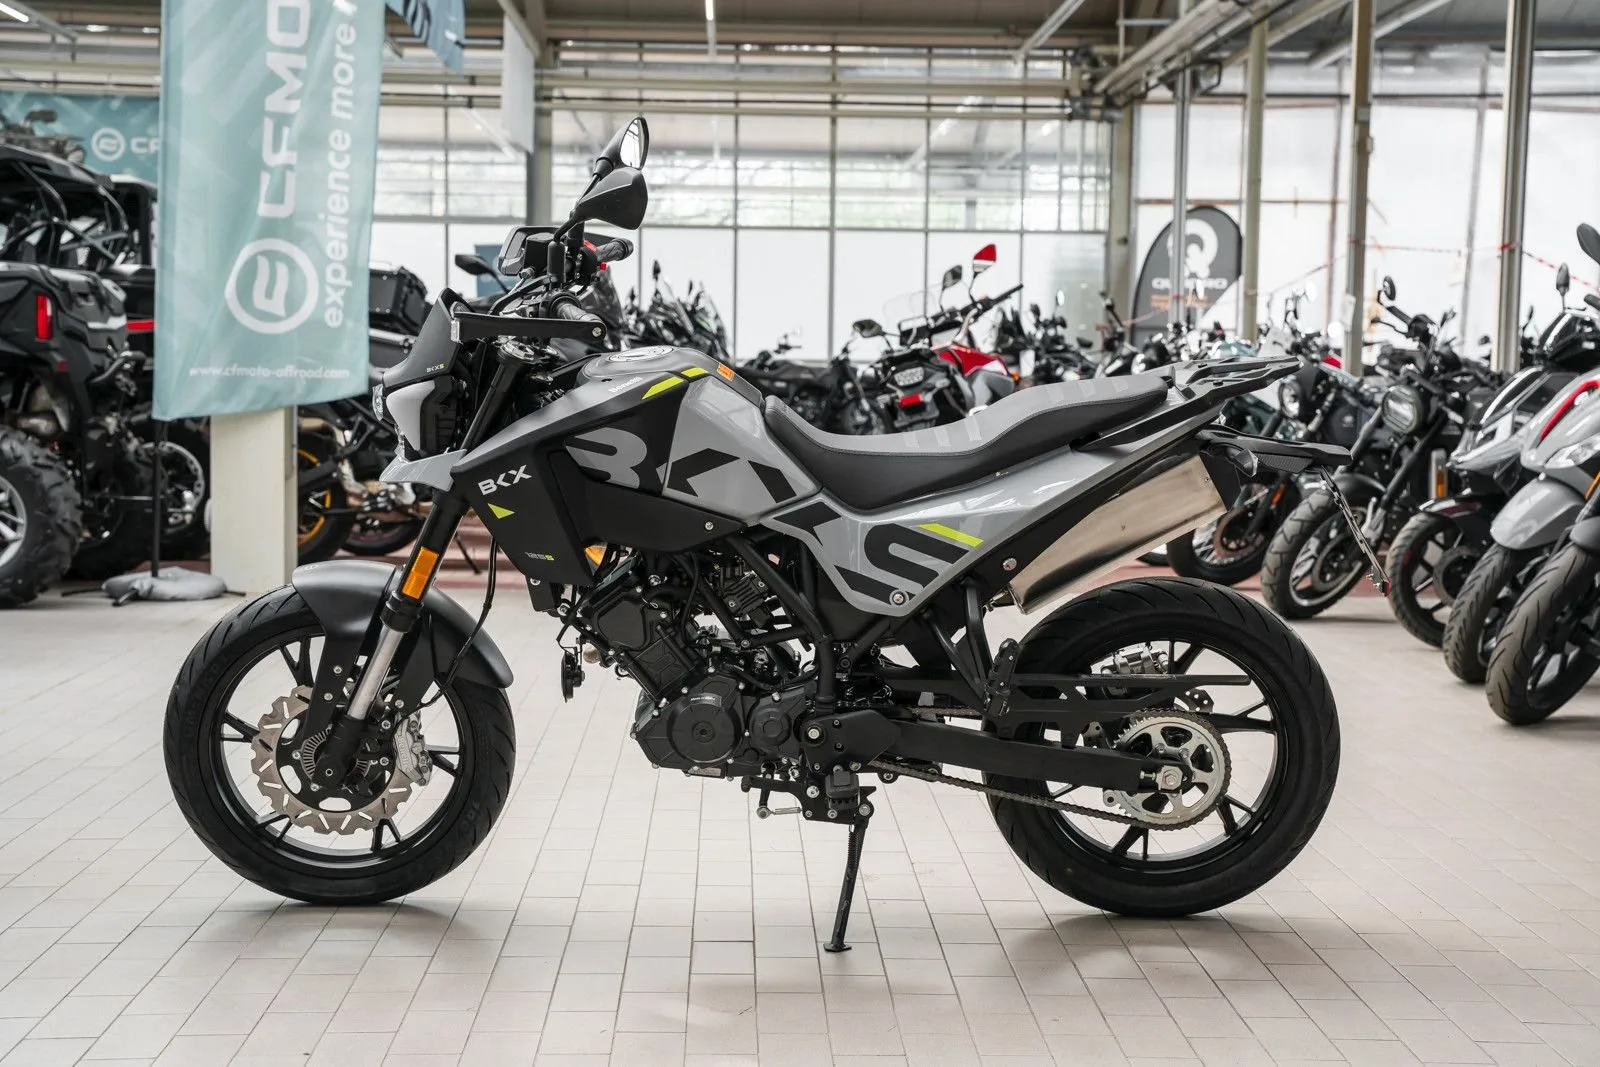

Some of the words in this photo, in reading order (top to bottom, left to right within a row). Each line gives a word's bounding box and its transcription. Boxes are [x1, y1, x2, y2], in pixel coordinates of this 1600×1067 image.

[330, 23, 357, 120] more
[319, 129, 352, 328] experience
[189, 363, 351, 379] www.cfmoto-offroad.com
[477, 464, 532, 496] BKX
